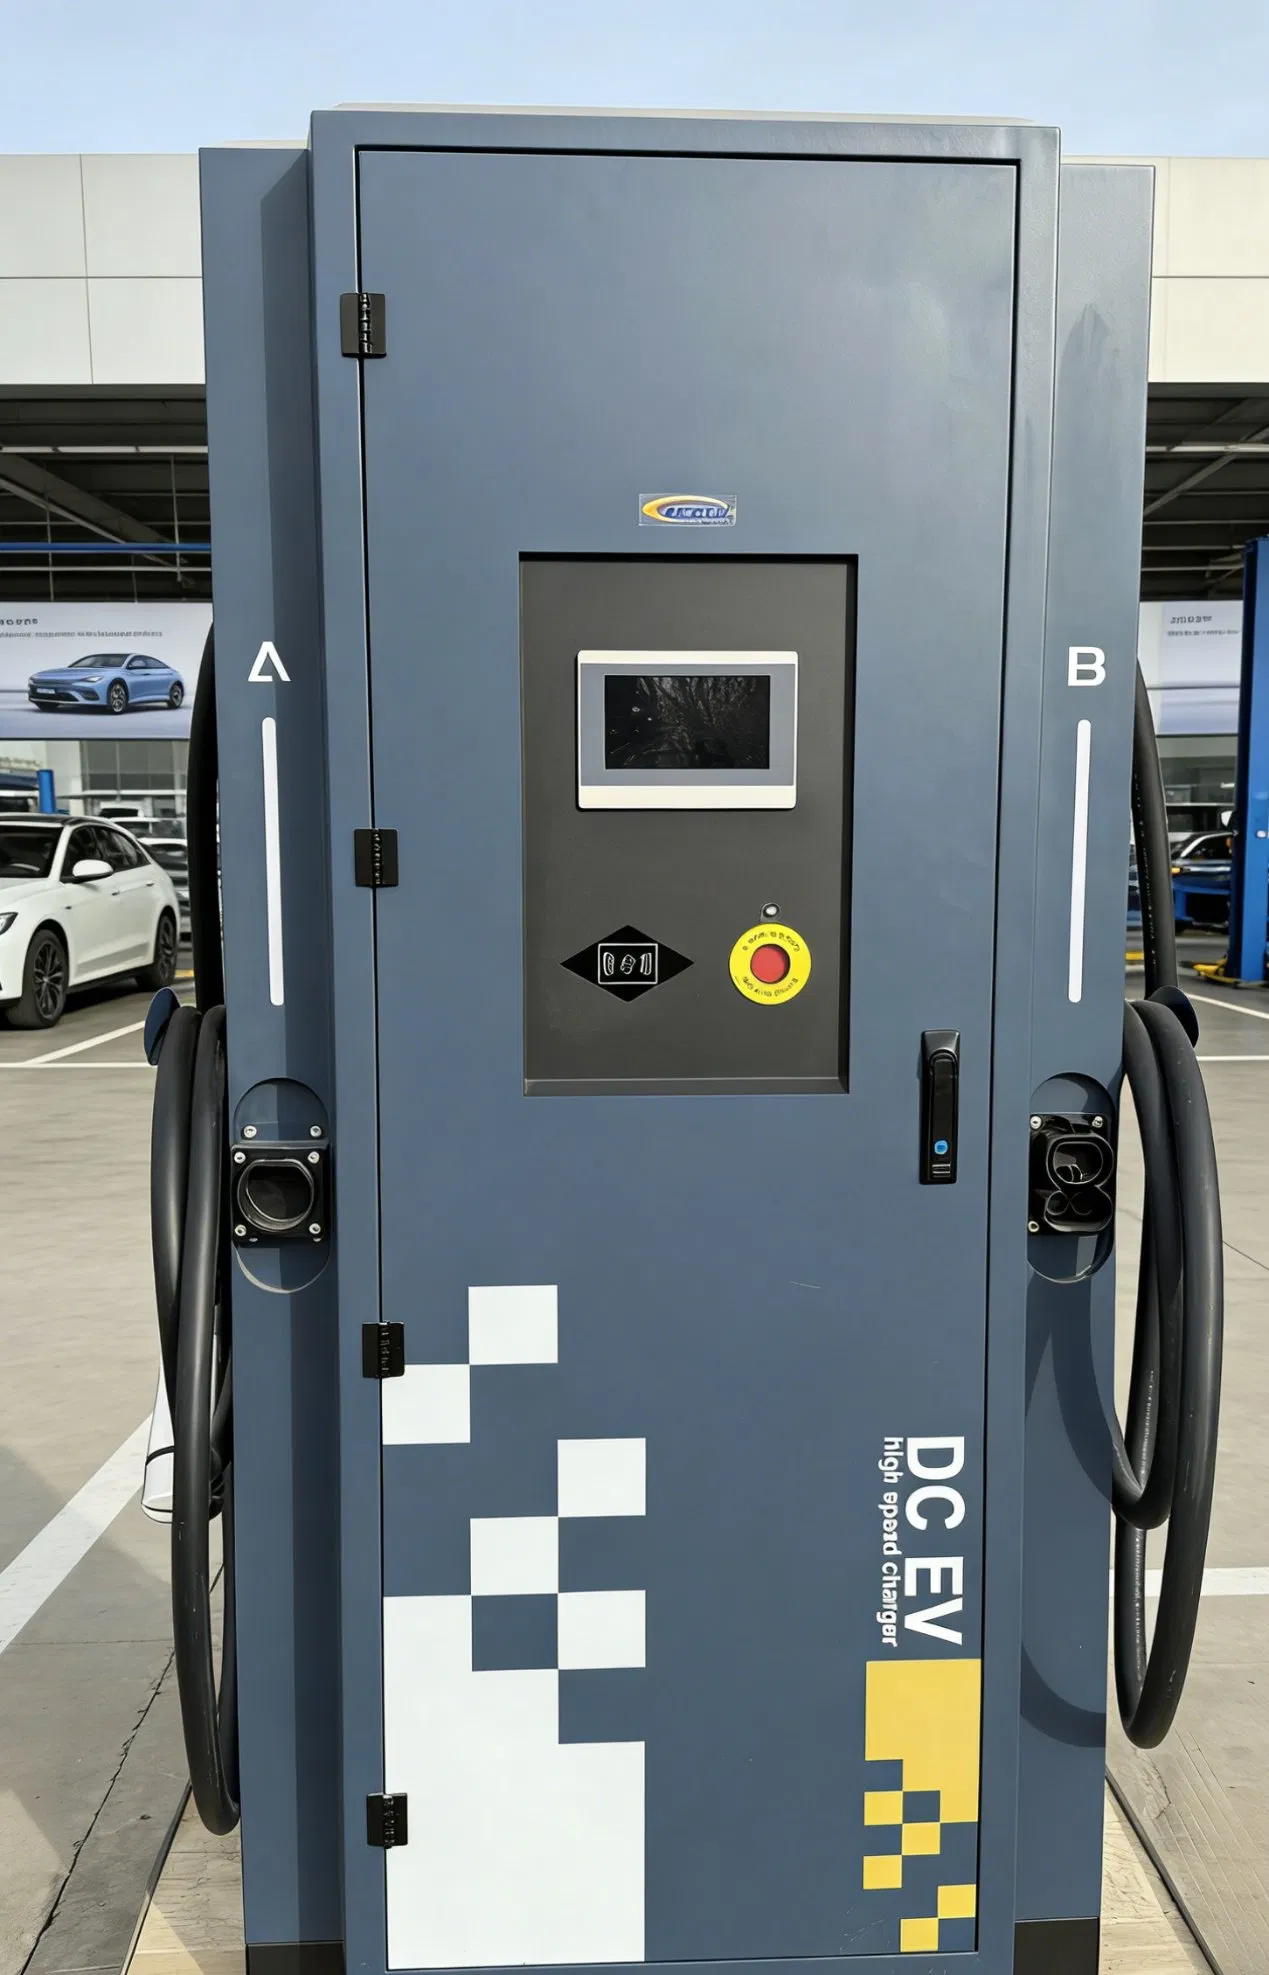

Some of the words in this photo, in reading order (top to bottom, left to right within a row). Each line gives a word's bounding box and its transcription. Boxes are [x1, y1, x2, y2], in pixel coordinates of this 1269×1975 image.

[248, 641, 291, 682] A
[1068, 646, 1106, 687] B
[905, 1436, 966, 1531] DC
[904, 1556, 964, 1646] EV
